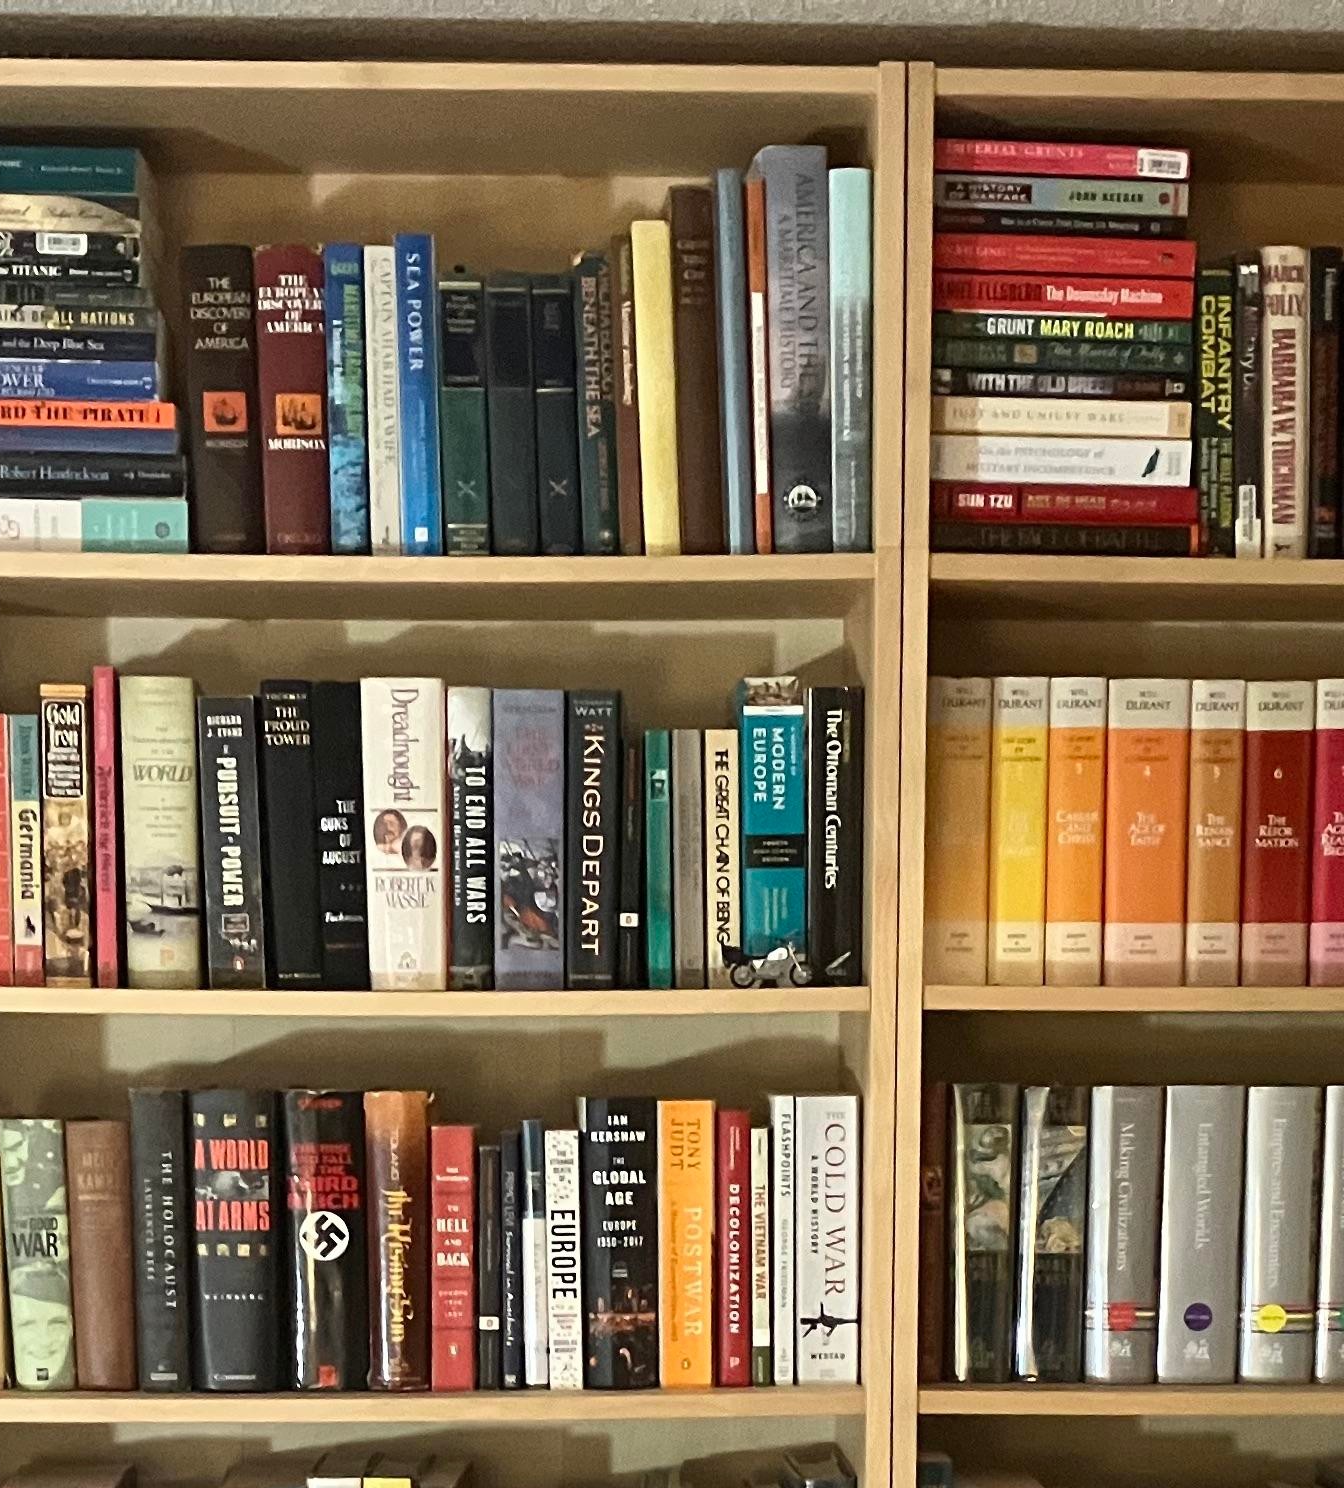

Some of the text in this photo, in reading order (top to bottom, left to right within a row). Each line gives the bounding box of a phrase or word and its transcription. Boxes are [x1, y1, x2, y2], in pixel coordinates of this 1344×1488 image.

[53, 311, 75, 326] ALL
[80, 310, 135, 326] NATIONS
[407, 253, 424, 371] SEA POWER
[1047, 286, 1063, 302] The
[987, 318, 1134, 338] GRUNT MARY ROACH
[1201, 295, 1216, 413] COMBAT
[1216, 295, 1232, 435] INFANTRY
[958, 493, 1013, 509] SUN TZU
[264, 720, 309, 732] PROUD
[575, 706, 612, 717] WATT
[265, 733, 310, 746] TOWER
[390, 689, 420, 803] Dreadnought
[753, 726, 767, 803] EUROPE
[771, 726, 786, 810] MODERN
[215, 757, 243, 907] PURSUIT POWER
[321, 816, 348, 831] GUNS
[465, 765, 486, 924] TO END ALL WARS
[580, 730, 605, 956] KINGS DEPART
[17, 808, 37, 900] Germania
[322, 850, 361, 864] AUGUST
[591, 1130, 646, 1143] KERSHAW
[607, 1115, 628, 1126] IAN
[670, 1118, 684, 1171] JUDT
[687, 1118, 701, 1171] TONY
[195, 1139, 268, 1170] A WORLD
[592, 1171, 647, 1186] GLOBAL
[781, 1113, 792, 1198] FLASHPOINTS
[196, 1201, 270, 1230] AT ARMS
[605, 1191, 633, 1206] AGE
[825, 1122, 847, 1297] COLD WAR
[13, 1232, 59, 1257] WAR
[161, 1151, 177, 1310] THE HOLOCAUST
[597, 1236, 644, 1248] 1950-2017
[602, 1220, 637, 1232] EUROPE
[756, 1185, 766, 1300] THE VIETNAM WAR
[551, 1210, 578, 1300] EUROPE
[681, 1206, 703, 1337] POSTWAR
[727, 1184, 740, 1335] DECOLONIZATION
